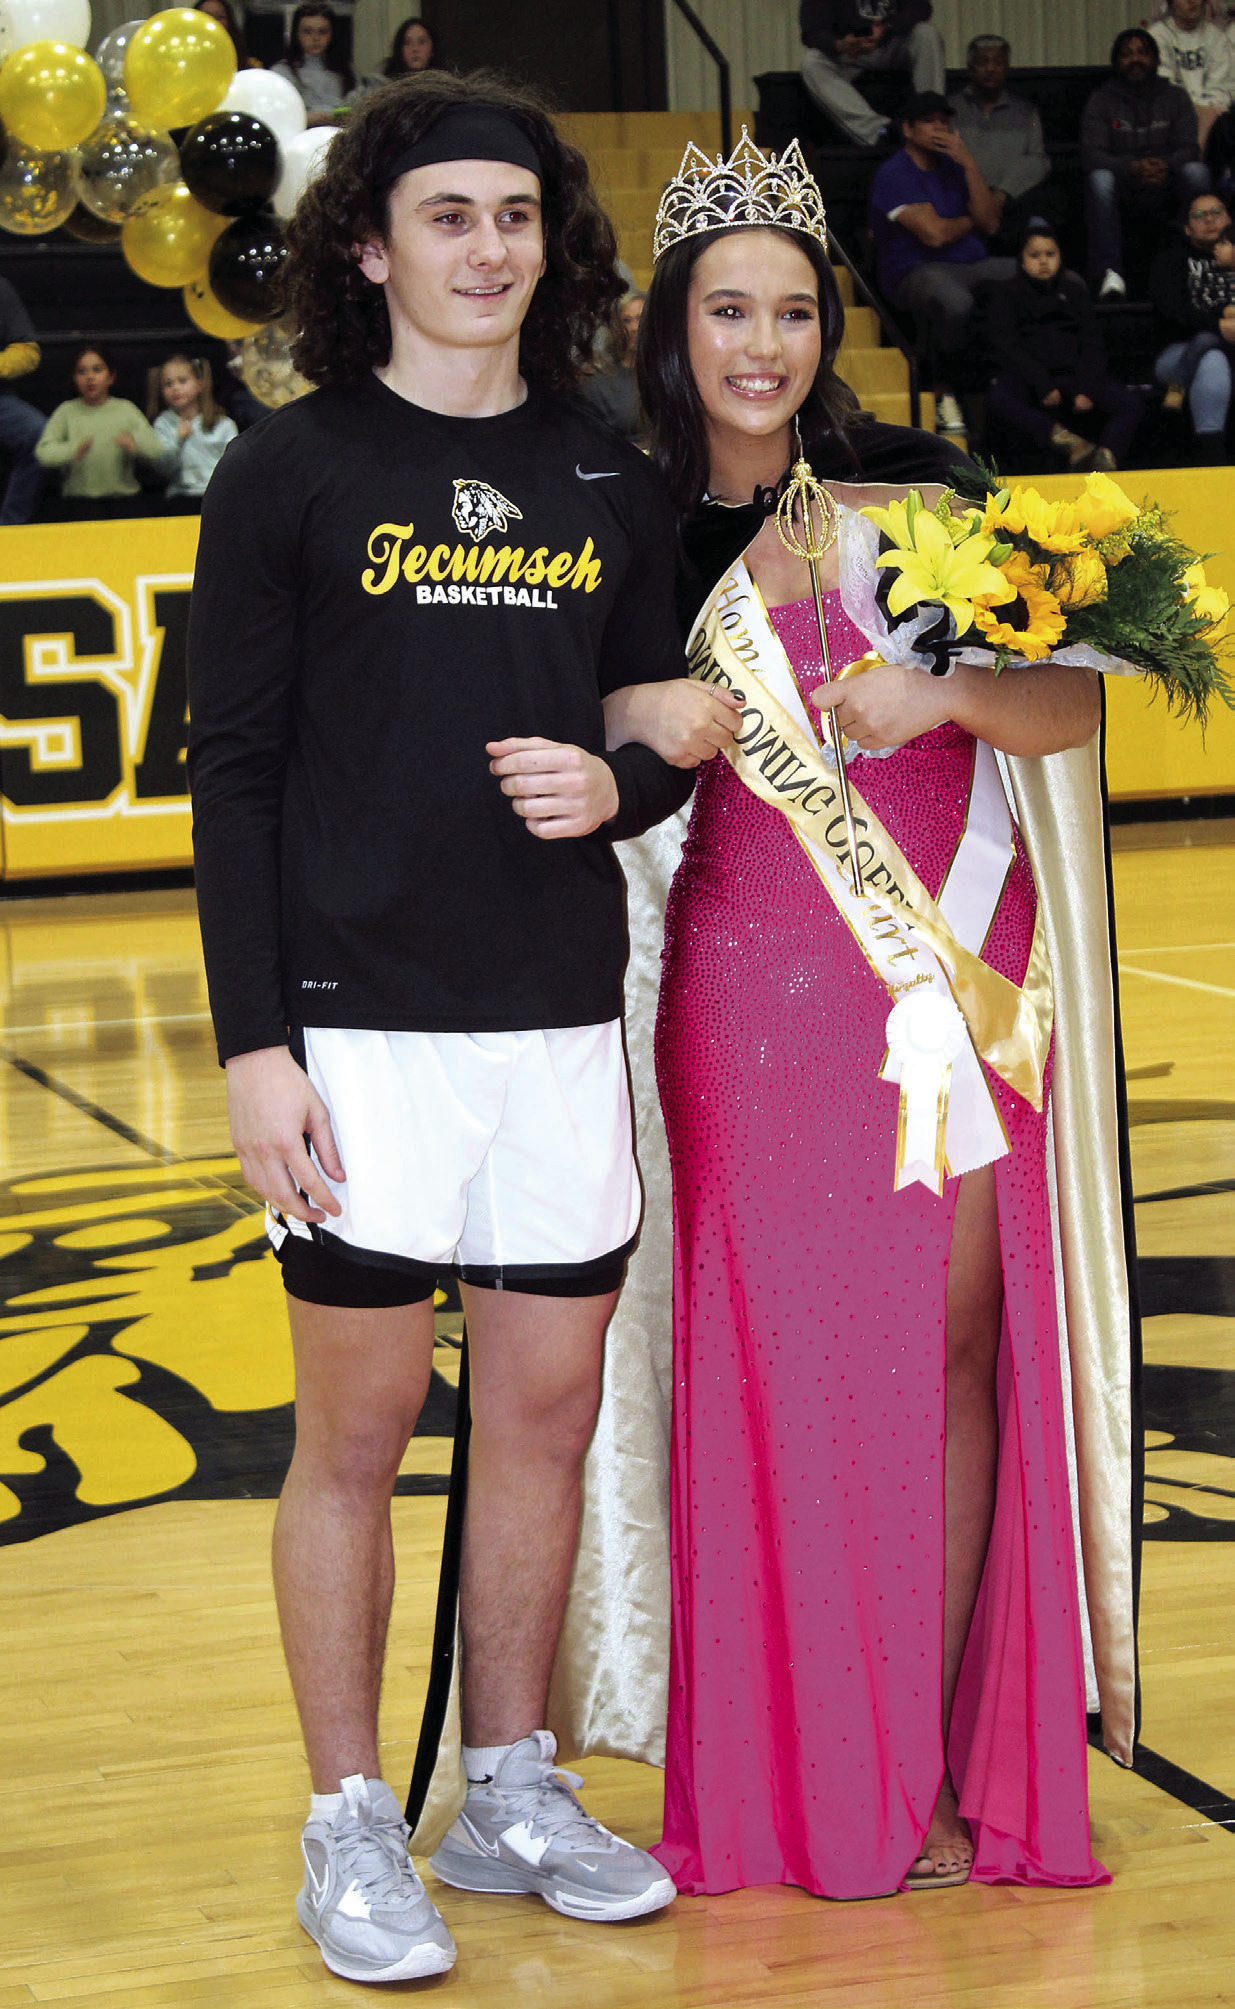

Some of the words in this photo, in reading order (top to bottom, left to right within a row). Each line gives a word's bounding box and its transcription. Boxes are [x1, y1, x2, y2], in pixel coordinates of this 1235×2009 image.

[361, 522, 602, 595] Tecumseh
[416, 584, 558, 609] BASKETBALL
[301, 980, 338, 990] DRI-FIT
